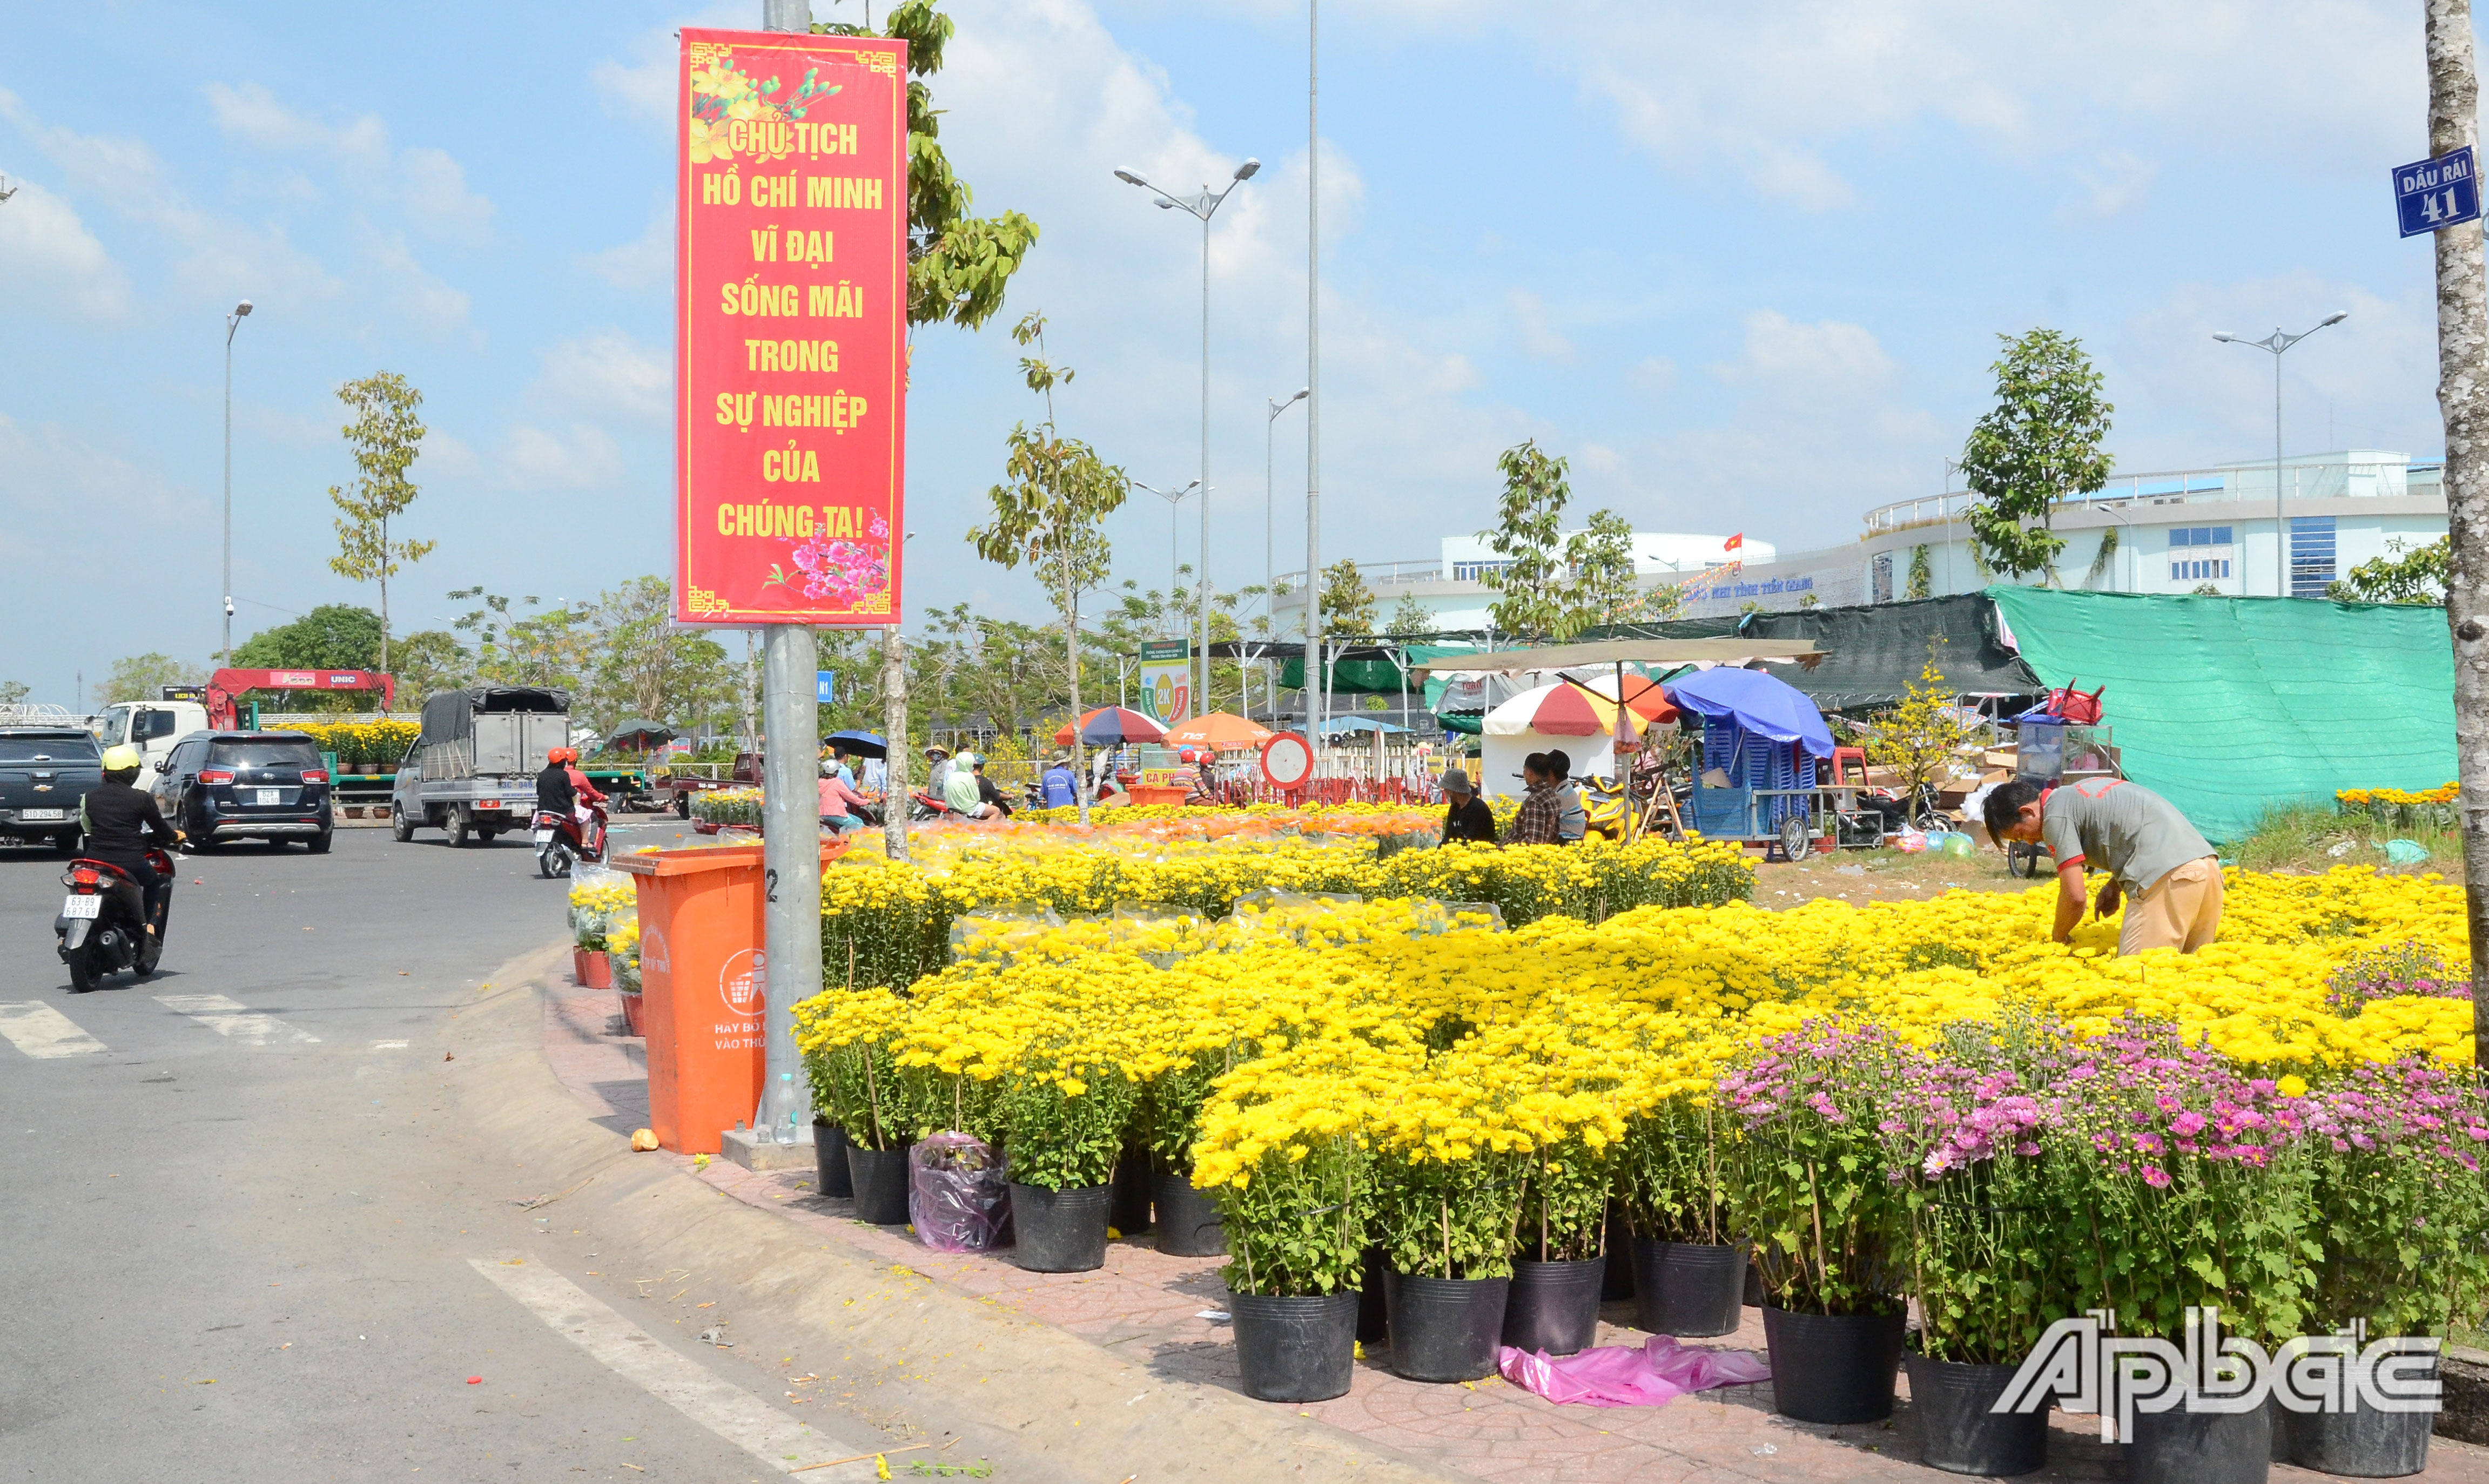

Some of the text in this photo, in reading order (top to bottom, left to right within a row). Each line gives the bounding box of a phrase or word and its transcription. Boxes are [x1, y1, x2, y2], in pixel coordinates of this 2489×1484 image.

[729, 112, 857, 160] CHỦ TỊCH
[703, 164, 882, 210] HỒ CHÍ MINH
[2404, 158, 2467, 193] DẦU RÁI
[2421, 186, 2460, 223] 41
[751, 224, 833, 269] VĨ ĐẠI
[721, 274, 863, 318] SỐNG MÃI
[745, 339, 838, 372] TRONG
[716, 389, 867, 435] SỰ NGHIỆP
[763, 440, 820, 482] CỦA
[718, 498, 863, 538] CHÚNG TA!
[331, 675, 355, 684] UNIC
[819, 681, 828, 695] N1
[1158, 689, 1170, 705] 2K
[1181, 732, 1207, 740] TVS
[1162, 773, 1175, 783] PH
[71, 897, 95, 906] 63-B9
[766, 868, 778, 902] 2
[715, 1037, 740, 1050] VÀO
